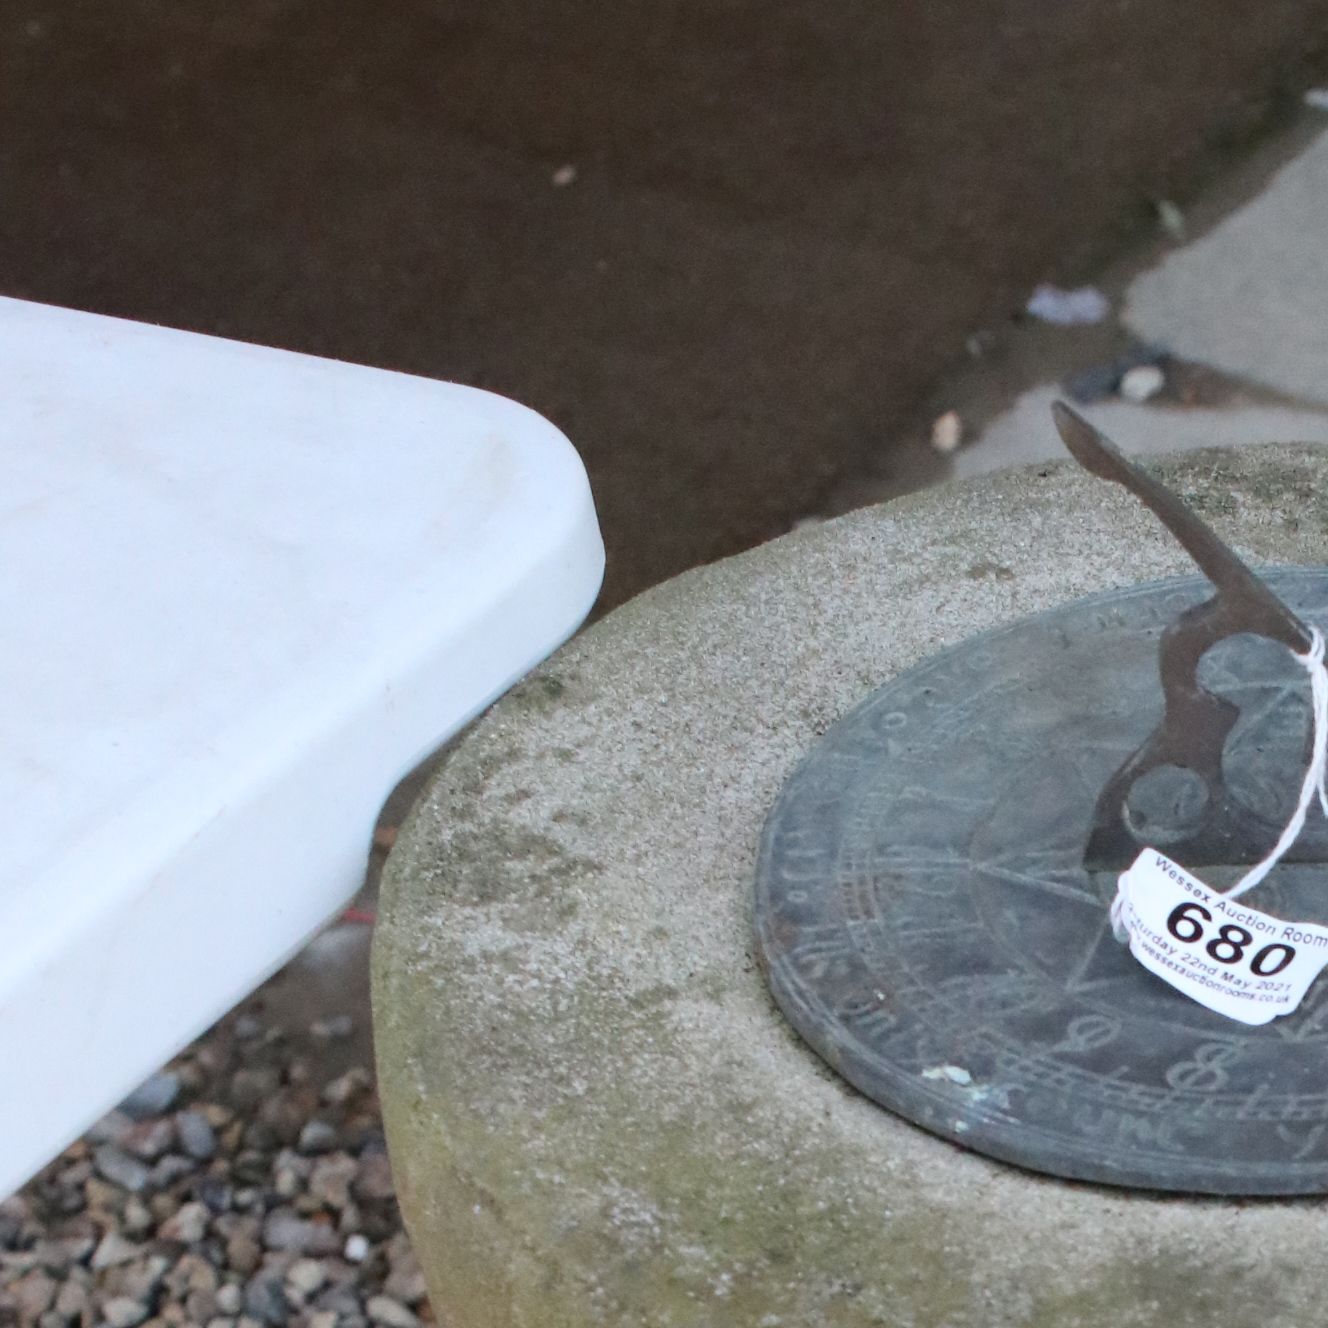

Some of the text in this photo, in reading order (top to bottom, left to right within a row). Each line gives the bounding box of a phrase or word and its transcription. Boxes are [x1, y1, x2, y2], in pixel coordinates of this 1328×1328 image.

[1155, 855, 1211, 903] Wessex
[1213, 900, 1276, 936] Auction
[1166, 901, 1297, 977] 680
[1180, 952, 1218, 976] 22nd
[1221, 971, 1252, 990] May
[1256, 980, 1293, 992] 2021
